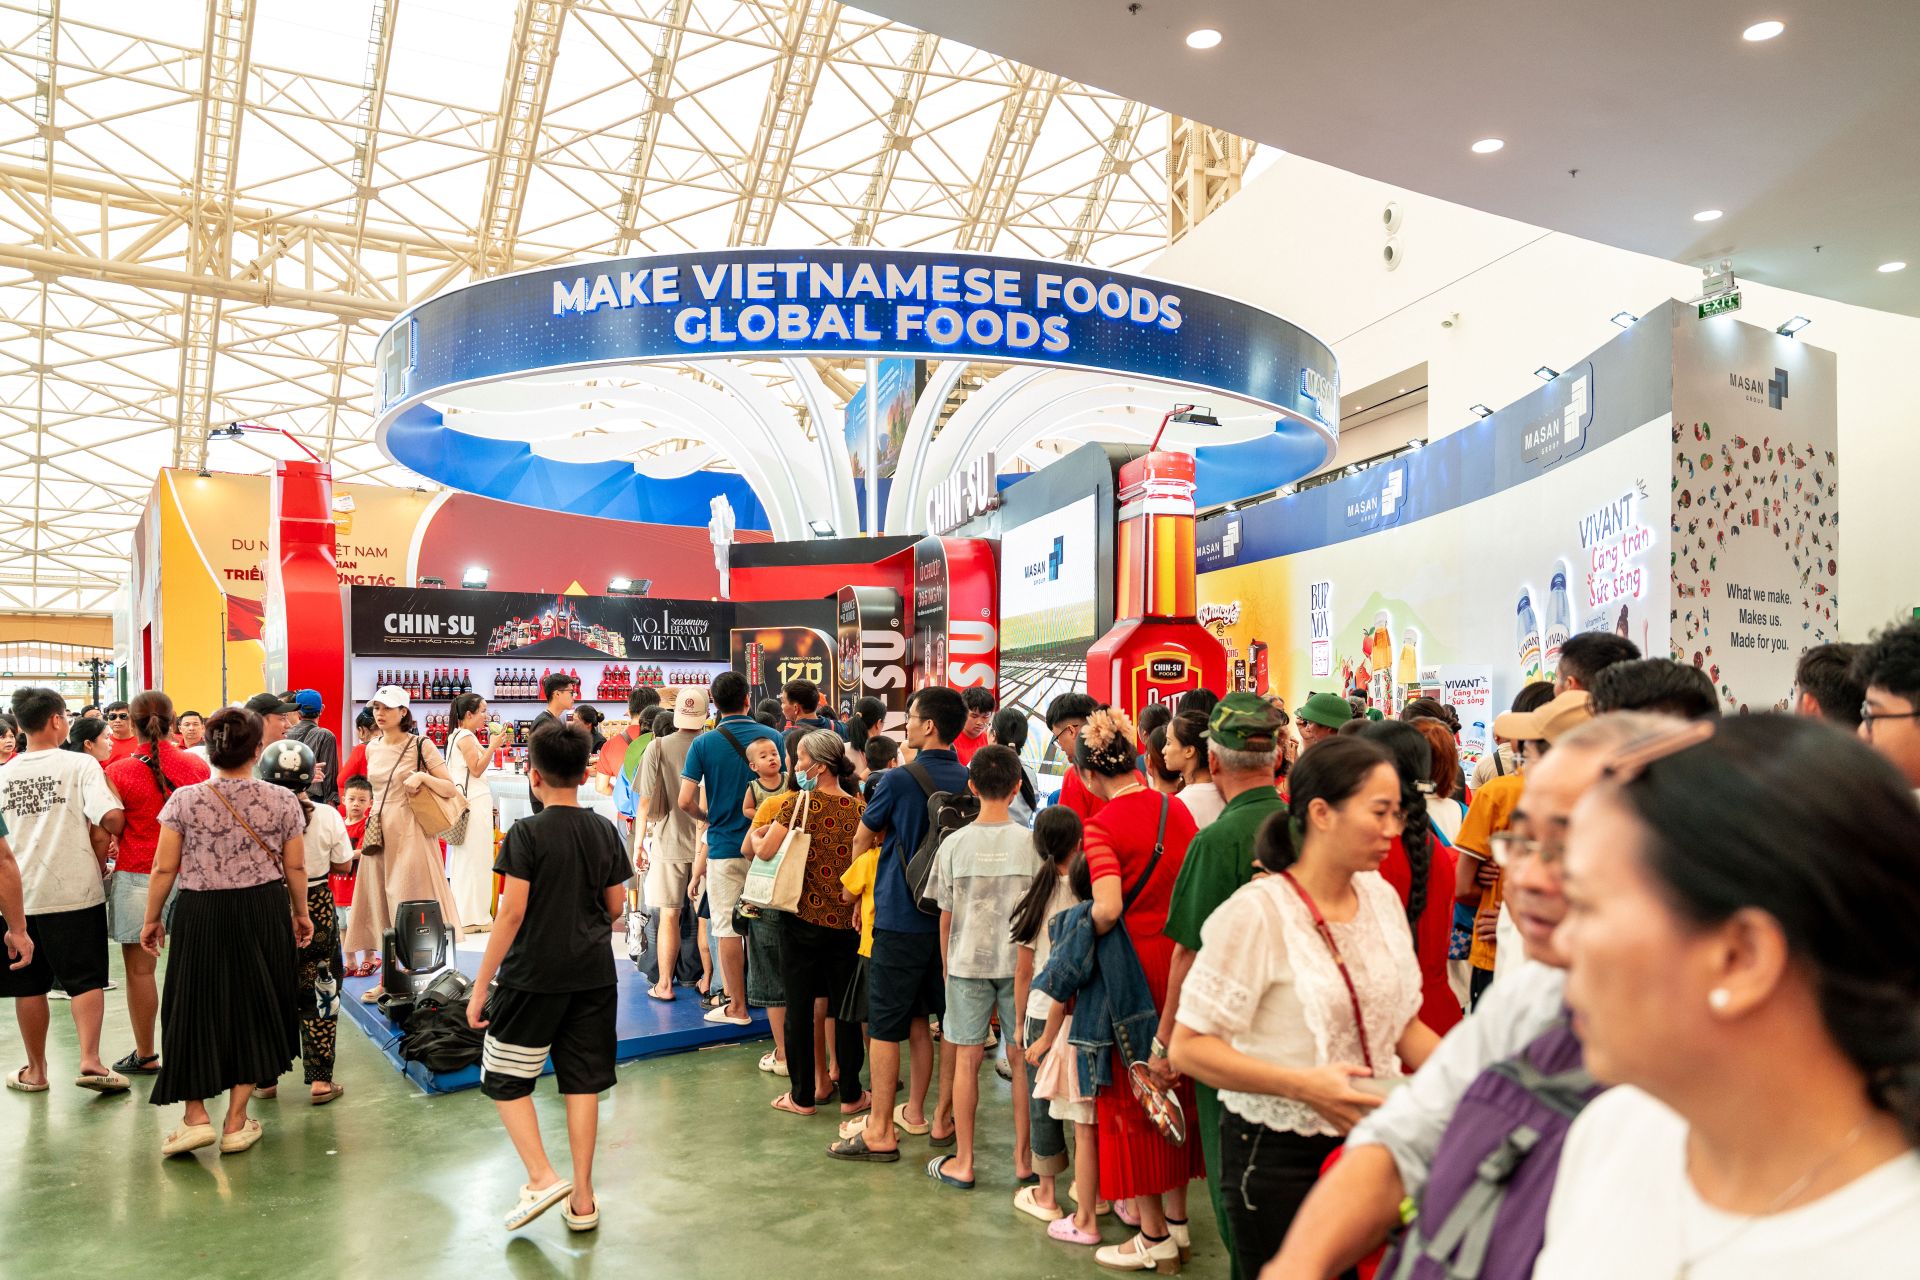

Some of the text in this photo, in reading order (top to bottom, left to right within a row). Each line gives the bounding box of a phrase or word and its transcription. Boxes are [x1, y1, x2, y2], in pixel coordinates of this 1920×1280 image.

[553, 263, 1183, 330] MAKE VIETNAMESE FOODS
[1703, 296, 1734, 312] EXIT
[674, 304, 1070, 352] GLOBAL FOODS
[1729, 372, 1764, 395] MASAN
[1524, 418, 1559, 451] MASAN
[926, 452, 991, 536] CHIN-SU
[1347, 496, 1378, 518] MASAN
[1579, 493, 1633, 549] VIVANT
[232, 539, 255, 551] DU
[260, 540, 269, 552] N
[355, 546, 388, 559] NAM
[1196, 541, 1220, 557] MASAN
[1024, 560, 1046, 579] MASAN
[368, 574, 396, 587] TÁC
[1726, 582, 1792, 605] What we make.
[384, 613, 475, 636] CHIN-SU
[671, 618, 709, 634] seasoning
[1739, 608, 1782, 627] Makes us.
[670, 625, 703, 636] BRAND
[632, 634, 710, 652] in VIETNAM
[1730, 631, 1789, 654] Made for you.
[1153, 663, 1182, 672] CHIN-SU
[1445, 678, 1481, 689] VIVANT
